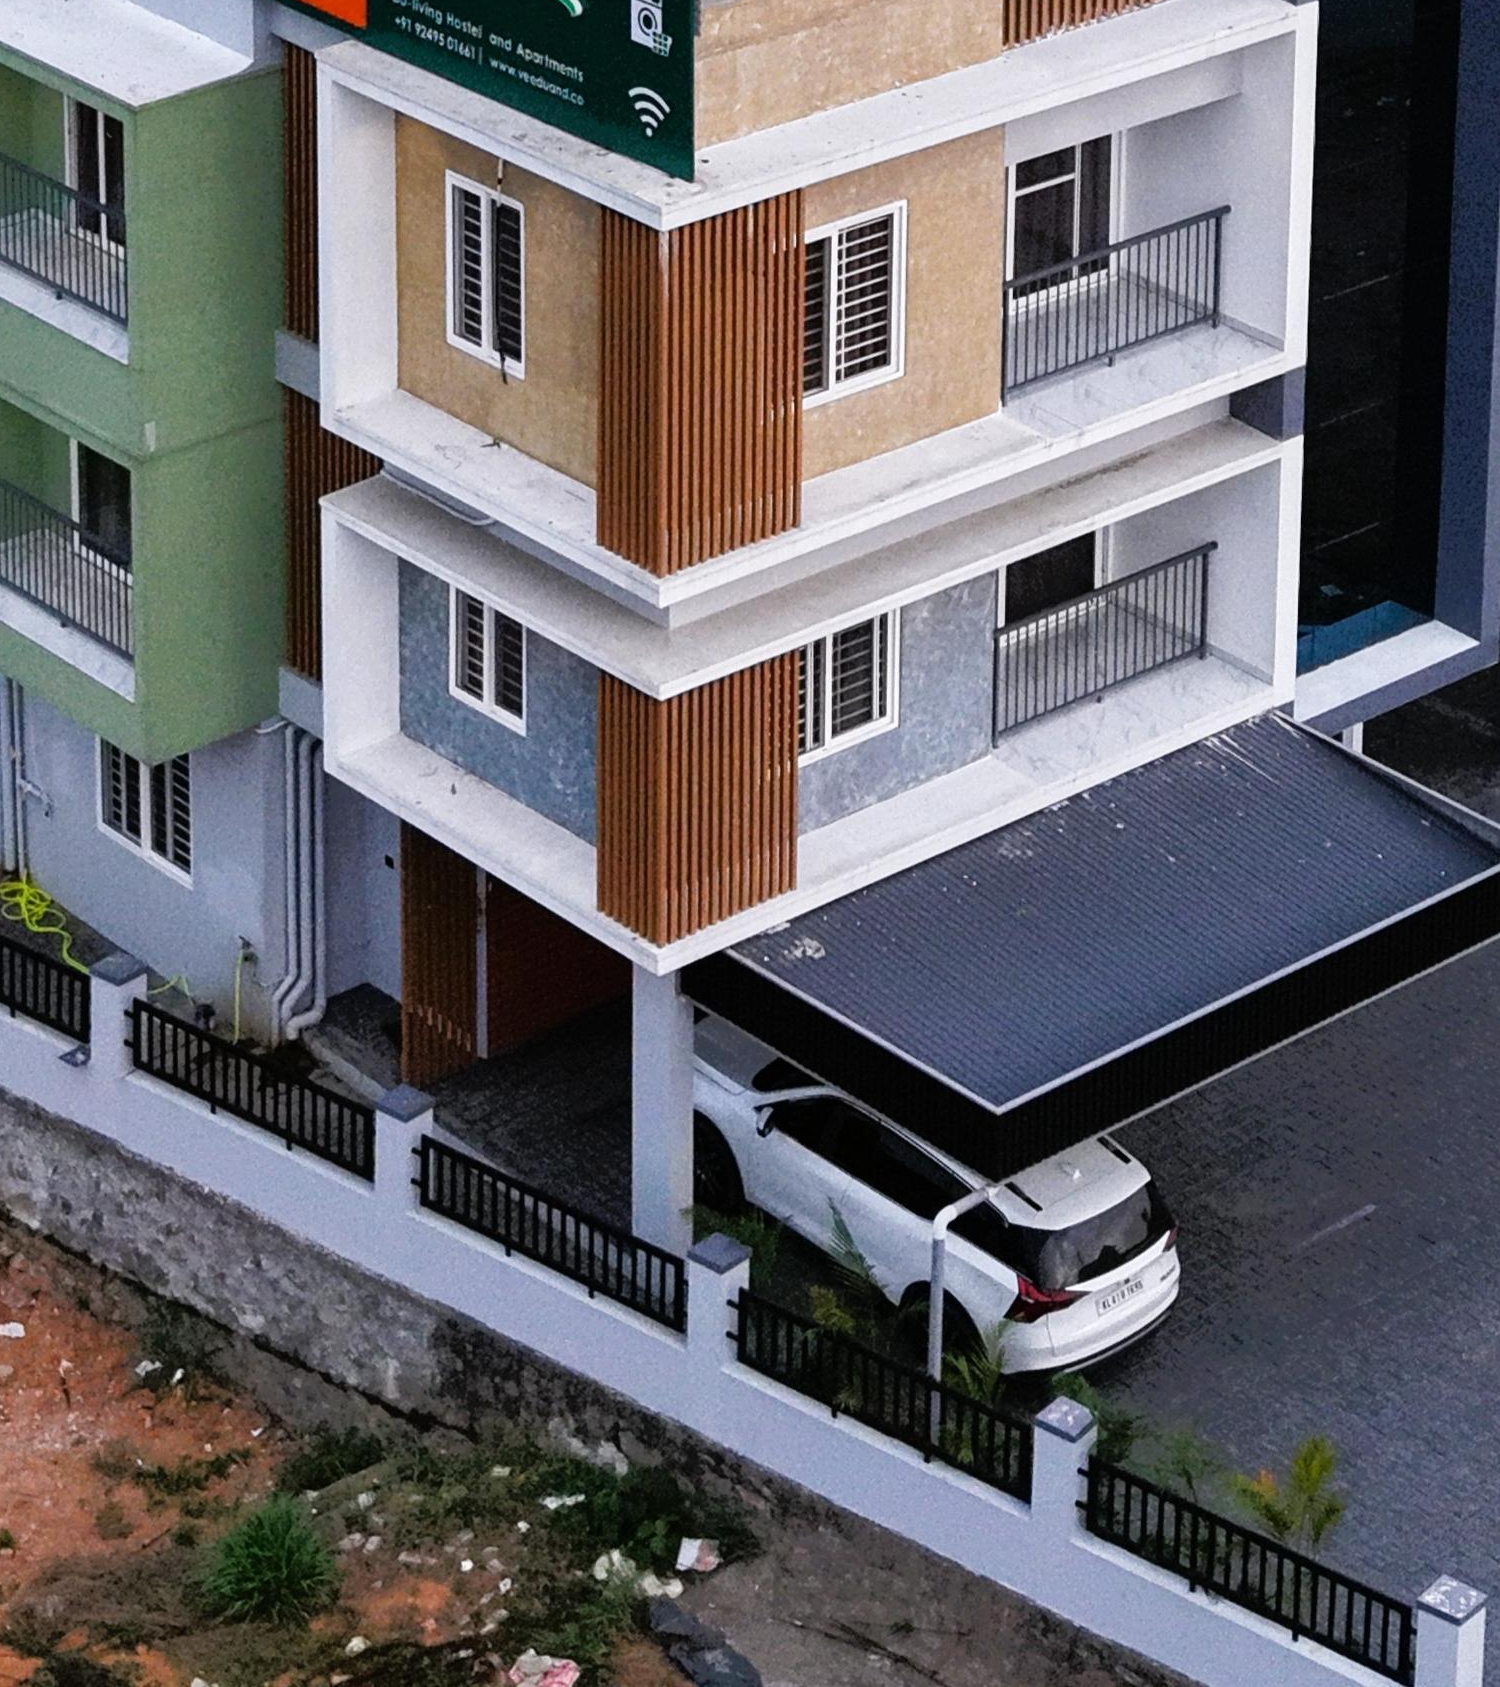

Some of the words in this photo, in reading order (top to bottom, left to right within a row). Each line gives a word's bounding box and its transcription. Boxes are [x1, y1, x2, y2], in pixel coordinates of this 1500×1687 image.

[394, 15, 412, 32] +91
[414, 22, 445, 47] 92495
[489, 57, 585, 106] www.veeduand.co
[446, 12, 484, 39] Hostel
[488, 32, 512, 52] and
[516, 42, 584, 82] Apartments
